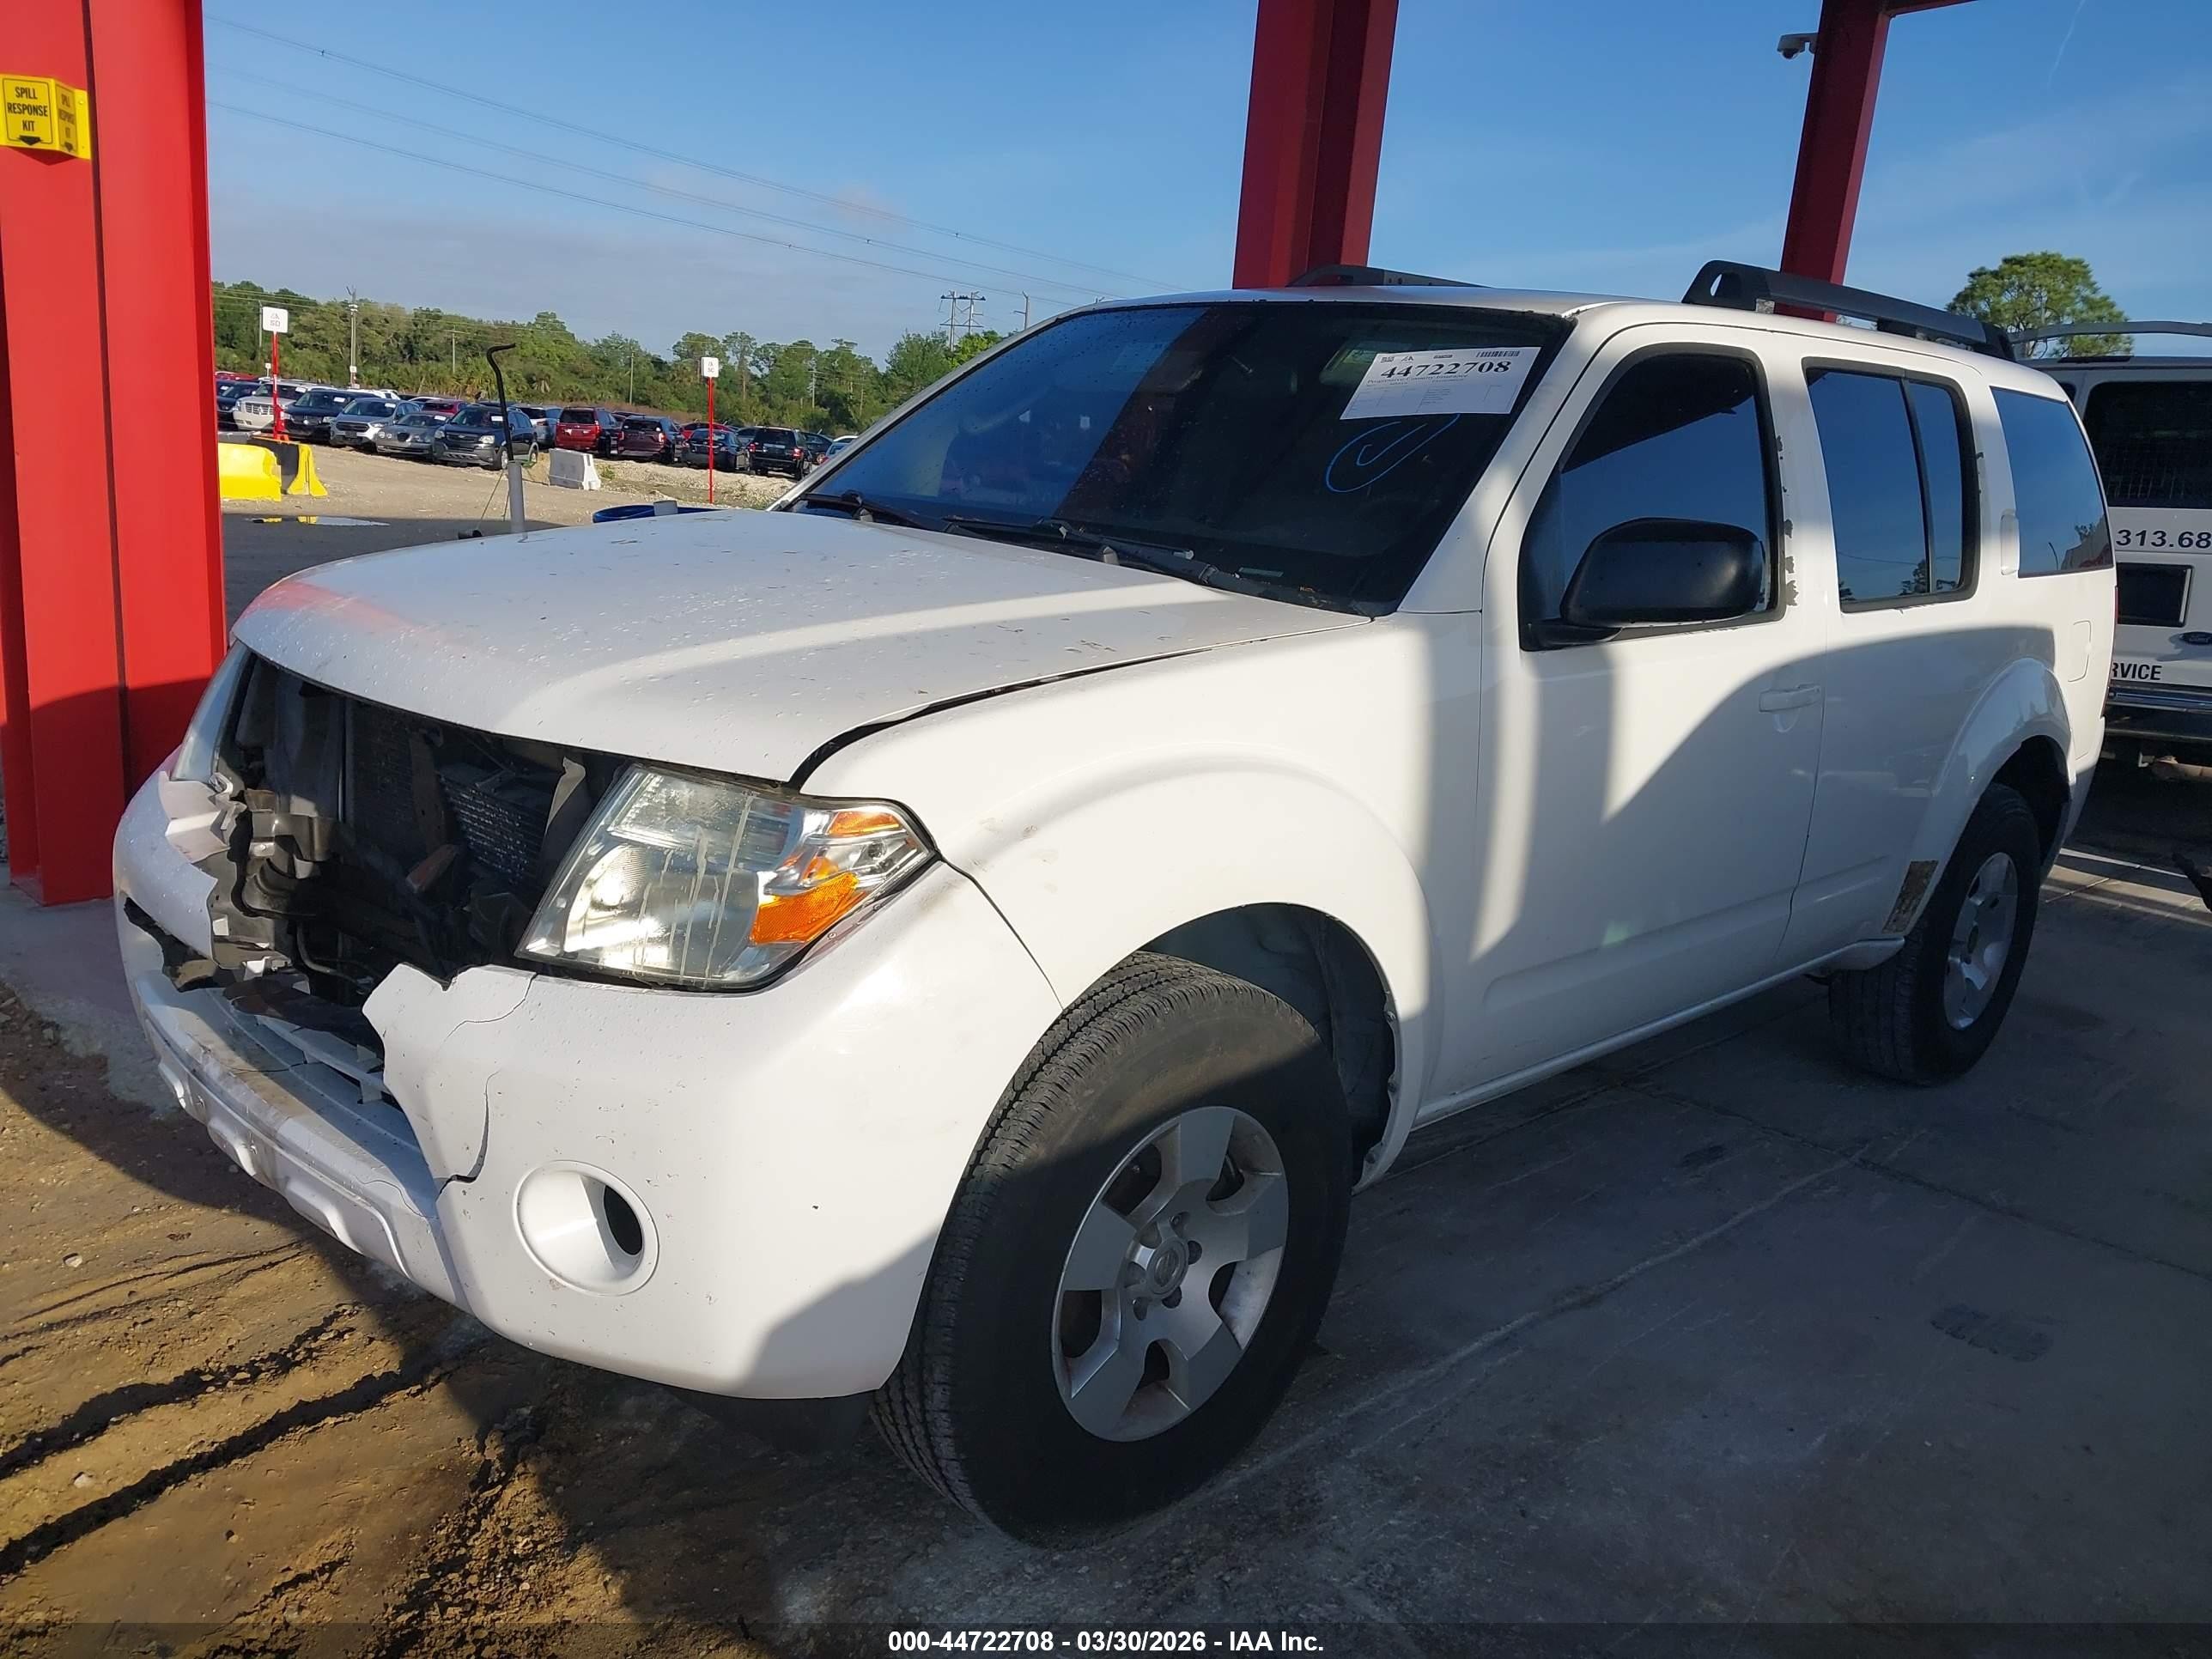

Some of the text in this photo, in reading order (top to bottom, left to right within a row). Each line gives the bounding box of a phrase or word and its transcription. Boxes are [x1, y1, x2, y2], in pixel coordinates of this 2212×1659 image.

[15, 87, 38, 100] SPILL
[7, 102, 48, 117] RESPONSE
[22, 120, 35, 131] KIT
[1381, 361, 1511, 378] 44722708
[2116, 529, 2211, 549] 313.68
